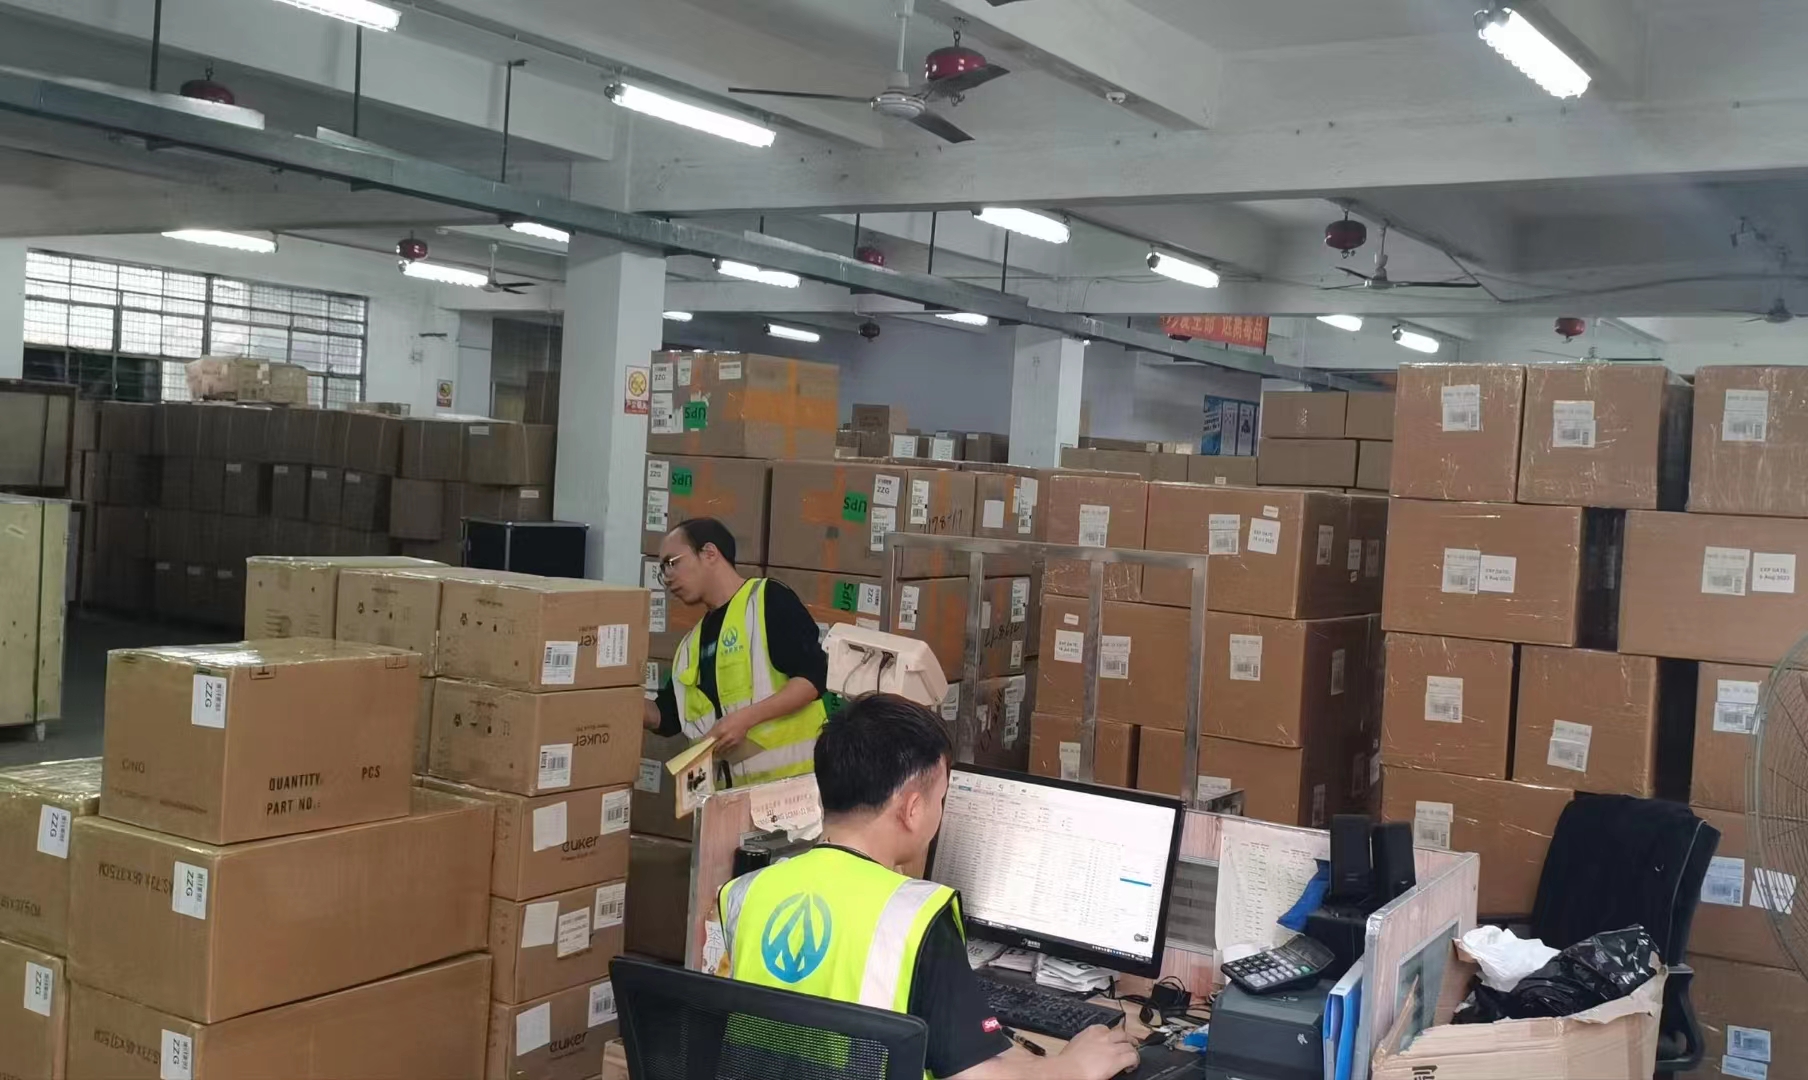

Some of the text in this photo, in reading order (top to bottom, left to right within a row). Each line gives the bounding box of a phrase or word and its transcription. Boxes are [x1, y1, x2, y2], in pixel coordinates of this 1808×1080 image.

[684, 406, 706, 420] UPS
[671, 472, 693, 488] UPS
[876, 485, 890, 494] ZZG
[843, 496, 867, 513] UPS
[840, 582, 855, 611] UPS
[578, 634, 599, 647] ker
[204, 681, 213, 708] ZZG
[361, 765, 381, 780] PCS
[266, 799, 293, 816] PART
[50, 812, 59, 838] ZZG
[185, 870, 195, 897] ZZG
[35, 970, 43, 996] ZZG
[172, 1037, 181, 1066] ZZG
